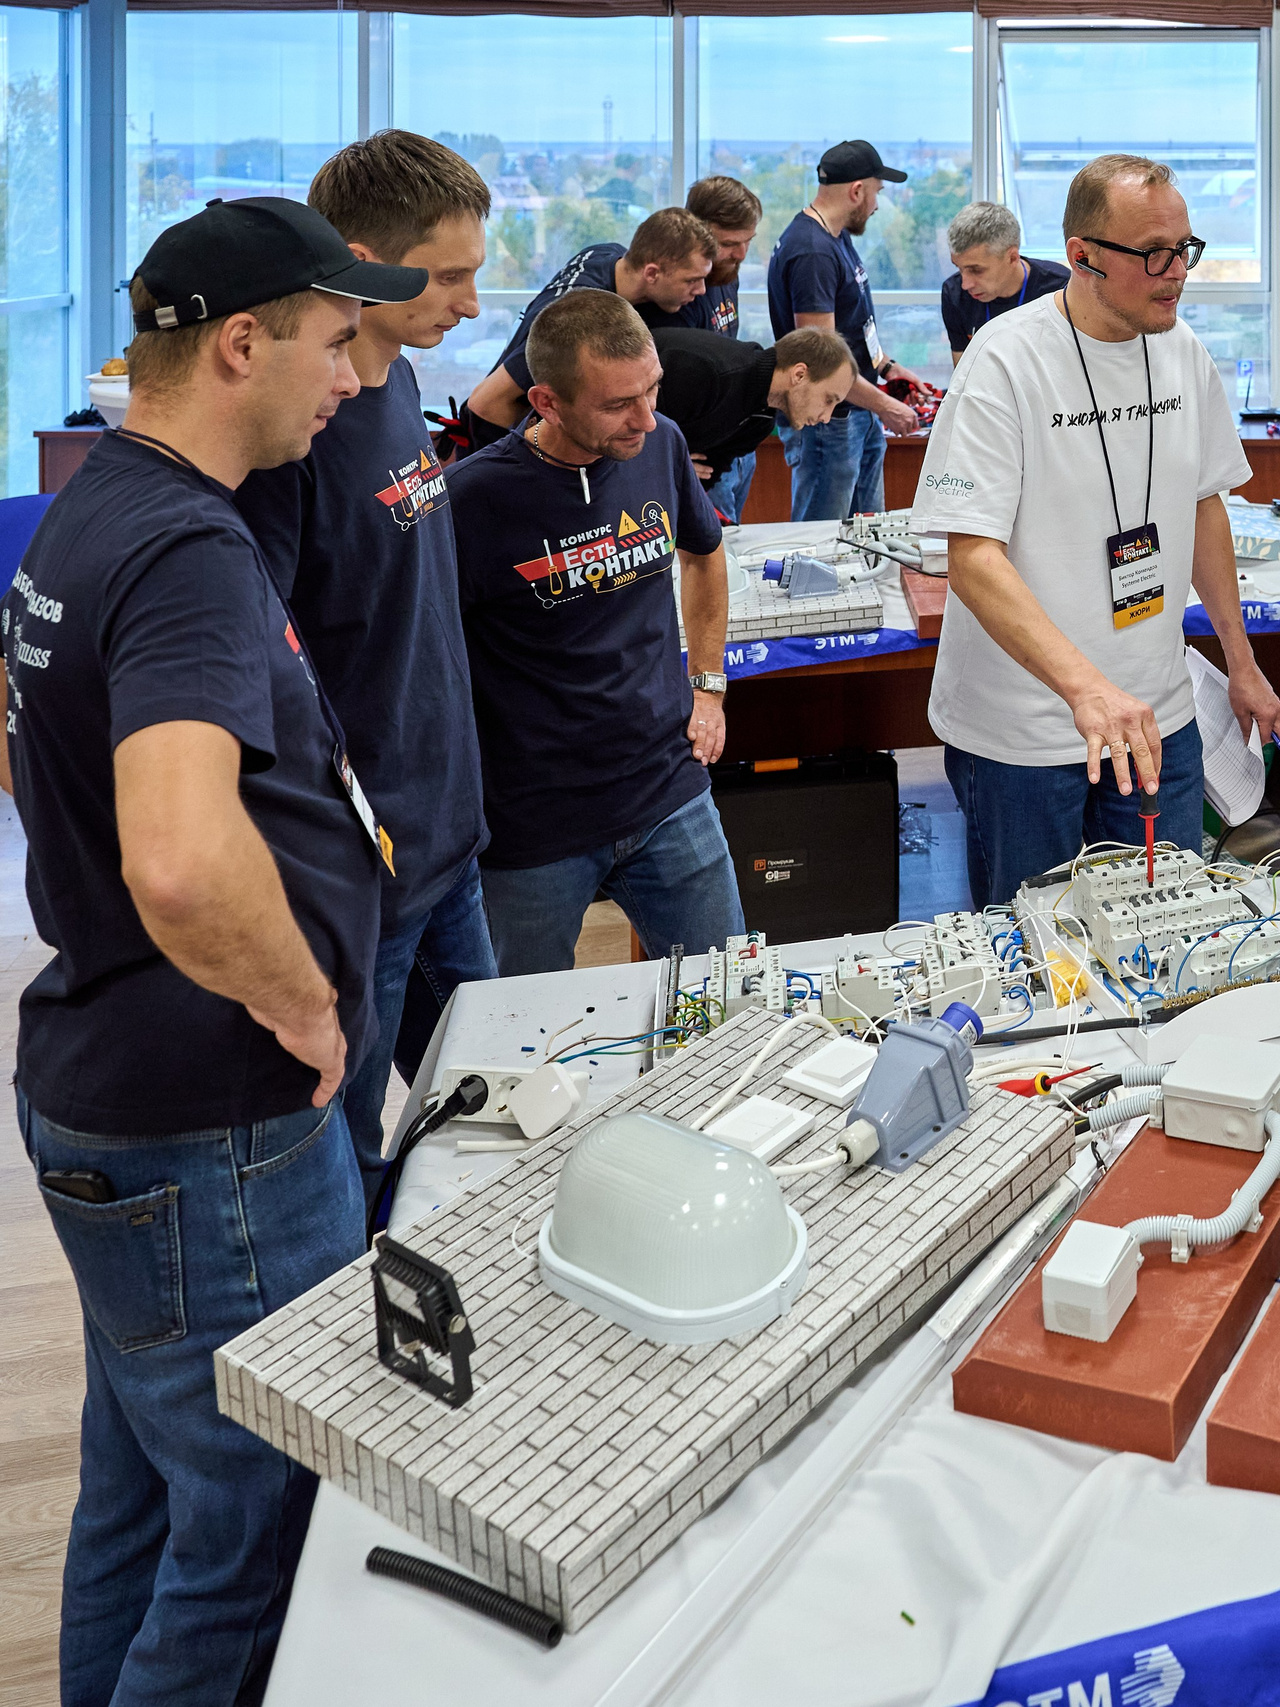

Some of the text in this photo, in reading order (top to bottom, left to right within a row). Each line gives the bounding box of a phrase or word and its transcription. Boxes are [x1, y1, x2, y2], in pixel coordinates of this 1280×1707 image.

[1051, 413, 1063, 428] Я
[1111, 407, 1122, 422] Я
[1126, 404, 1148, 421] ТАК
[938, 487, 972, 499] ectric
[559, 523, 612, 548] КОНКУРС
[567, 535, 667, 589] КОНТАКТ
[1129, 605, 1151, 620] ЖЮРИ
[814, 634, 856, 650] ЭТМ
